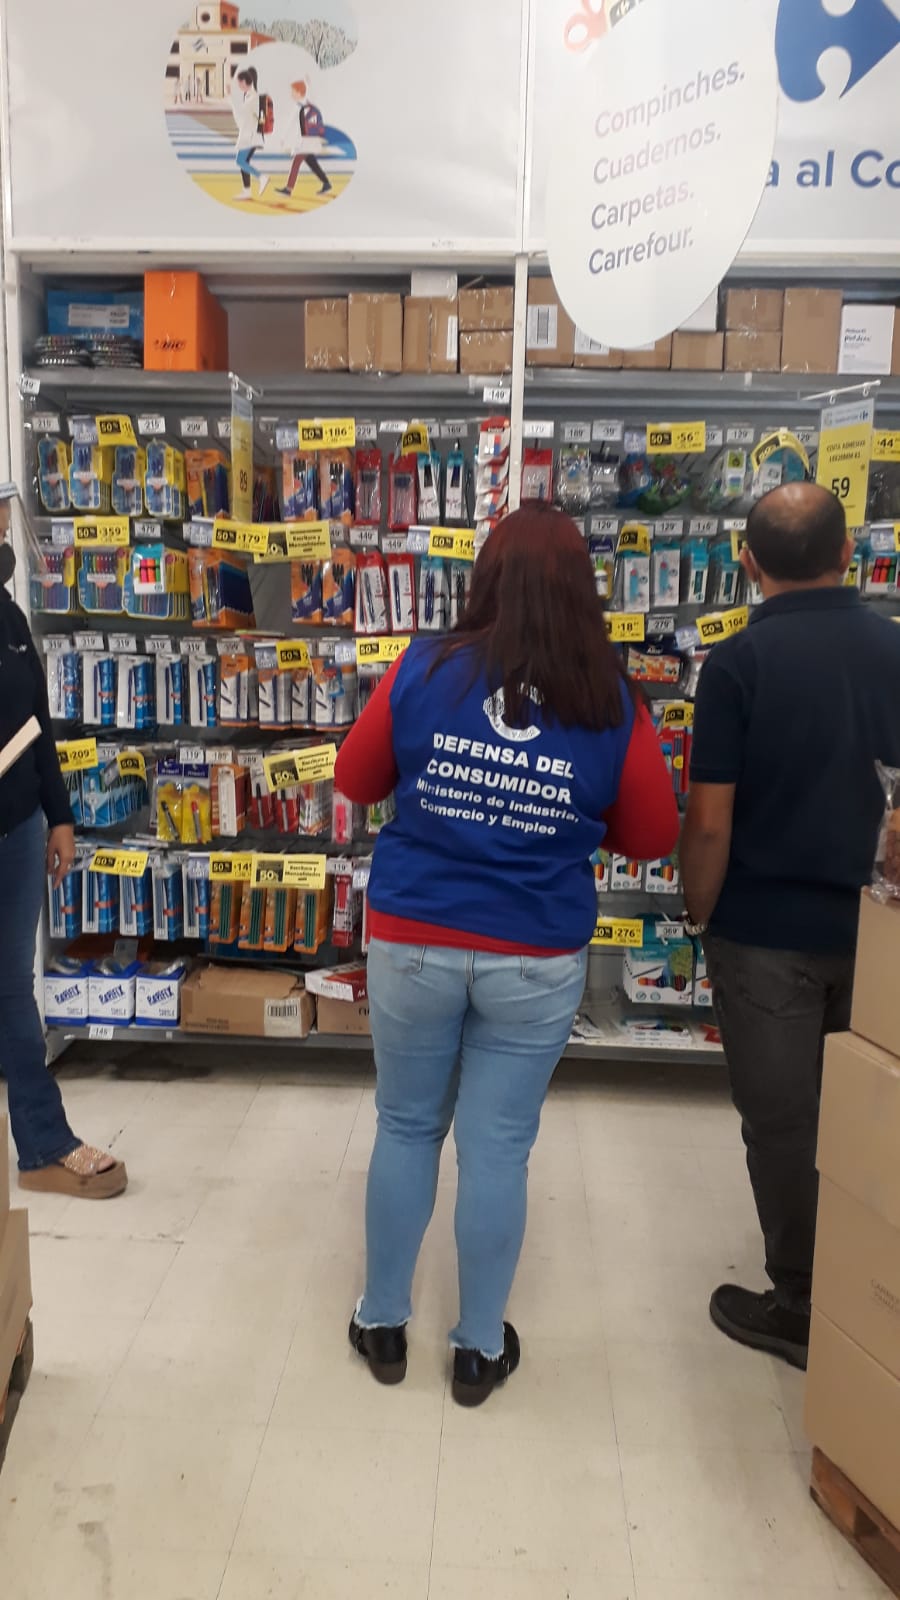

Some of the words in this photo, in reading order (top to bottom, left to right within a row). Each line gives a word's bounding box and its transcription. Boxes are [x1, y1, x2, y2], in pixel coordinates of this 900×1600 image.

[594, 60, 745, 138] Compinches.
[593, 121, 722, 185] Cuadernos.
[797, 150, 835, 187] al
[590, 180, 695, 230] Carpetas.
[588, 225, 694, 275] Carrefour.
[831, 476, 851, 499] 59
[433, 733, 529, 768] DEFENSA
[536, 755, 575, 779] DEL
[416, 778, 482, 803] Ministerio
[486, 795, 505, 808] de
[509, 799, 580, 823] Industria,
[426, 759, 572, 804] CONSUMIDOR
[420, 798, 485, 821] Comercio
[488, 814, 497, 825] y
[502, 815, 557, 835] Empleo
